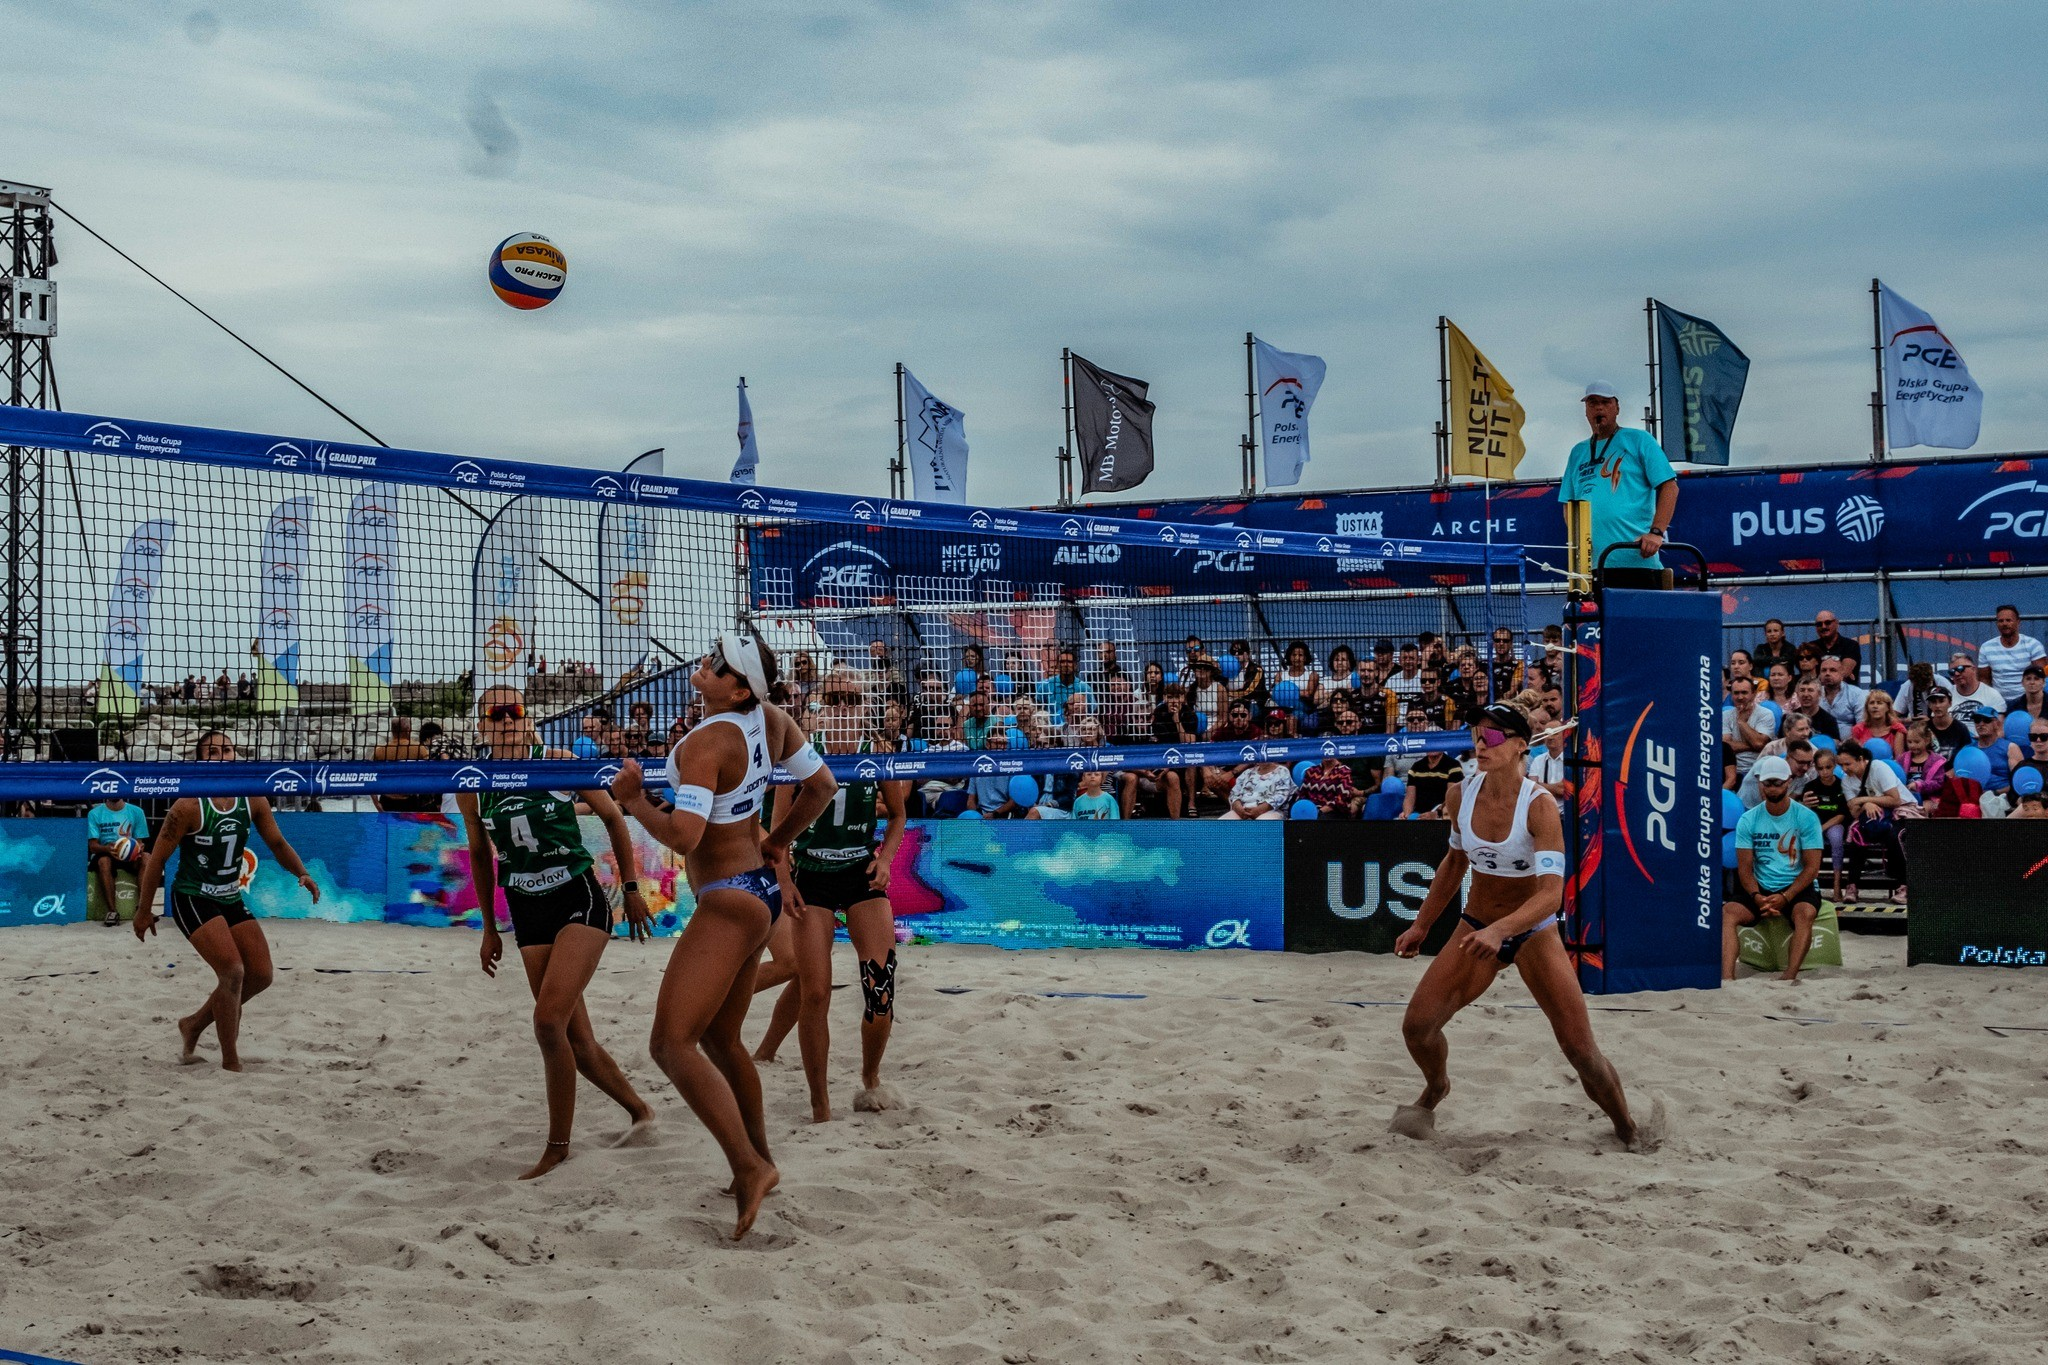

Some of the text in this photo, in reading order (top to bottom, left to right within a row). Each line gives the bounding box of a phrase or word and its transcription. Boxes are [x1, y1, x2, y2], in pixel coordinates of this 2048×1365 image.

[514, 266, 535, 276] PRO
[1902, 344, 1957, 369] PGE
[1933, 379, 1969, 393] Grupa
[1468, 389, 1487, 455] NICE
[93, 434, 121, 447] PGE
[137, 434, 182, 446] Polska Grupa
[1488, 413, 1511, 458] FIT
[135, 443, 181, 454] Energetyczna
[273, 454, 298, 466] PGE
[329, 453, 357, 464] GRAND
[358, 455, 377, 466] PRIX
[1099, 454, 1114, 482] MB
[456, 472, 478, 483] PGE
[491, 471, 525, 481] Polska Grupa
[597, 487, 616, 497] PGE
[641, 484, 663, 494] GRAND
[664, 486, 679, 495] PRIX
[742, 500, 760, 510] PGE
[854, 510, 871, 520] PGE
[890, 507, 908, 516] GRAND
[909, 509, 921, 517] PRIX
[972, 519, 987, 528] PGE
[1342, 518, 1377, 532] USTKA
[1432, 518, 1517, 536] ARCHE
[1733, 501, 1826, 546] plus
[1064, 528, 1078, 536] PGE
[1161, 534, 1174, 543] PGE
[942, 543, 1001, 558] NICE TO
[942, 559, 965, 573] FIT
[1193, 549, 1255, 574] PGE
[818, 564, 873, 588] PGE
[753, 743, 763, 768] 4
[895, 762, 912, 770] GRAND
[978, 764, 992, 773] PGE
[1070, 761, 1084, 770] PGE
[330, 773, 357, 782] GRAND
[358, 773, 378, 782] PRIX
[511, 773, 528, 782] Grupa
[860, 769, 876, 778] PGE
[159, 777, 180, 786] Grupa
[274, 780, 298, 792] PGE
[459, 777, 480, 788] PGE
[492, 781, 527, 790] Energetyczna
[90, 781, 119, 794] PGE
[134, 785, 180, 795] Energetyczna
[1698, 654, 1715, 930] Polska Grupa Energetyczna
[1646, 739, 1676, 852] PGE
[220, 823, 237, 832] PGE
[510, 814, 540, 853] 4
[220, 834, 238, 868] 7
[1478, 851, 1498, 859] PGE
[1960, 945, 2046, 965] Polska
